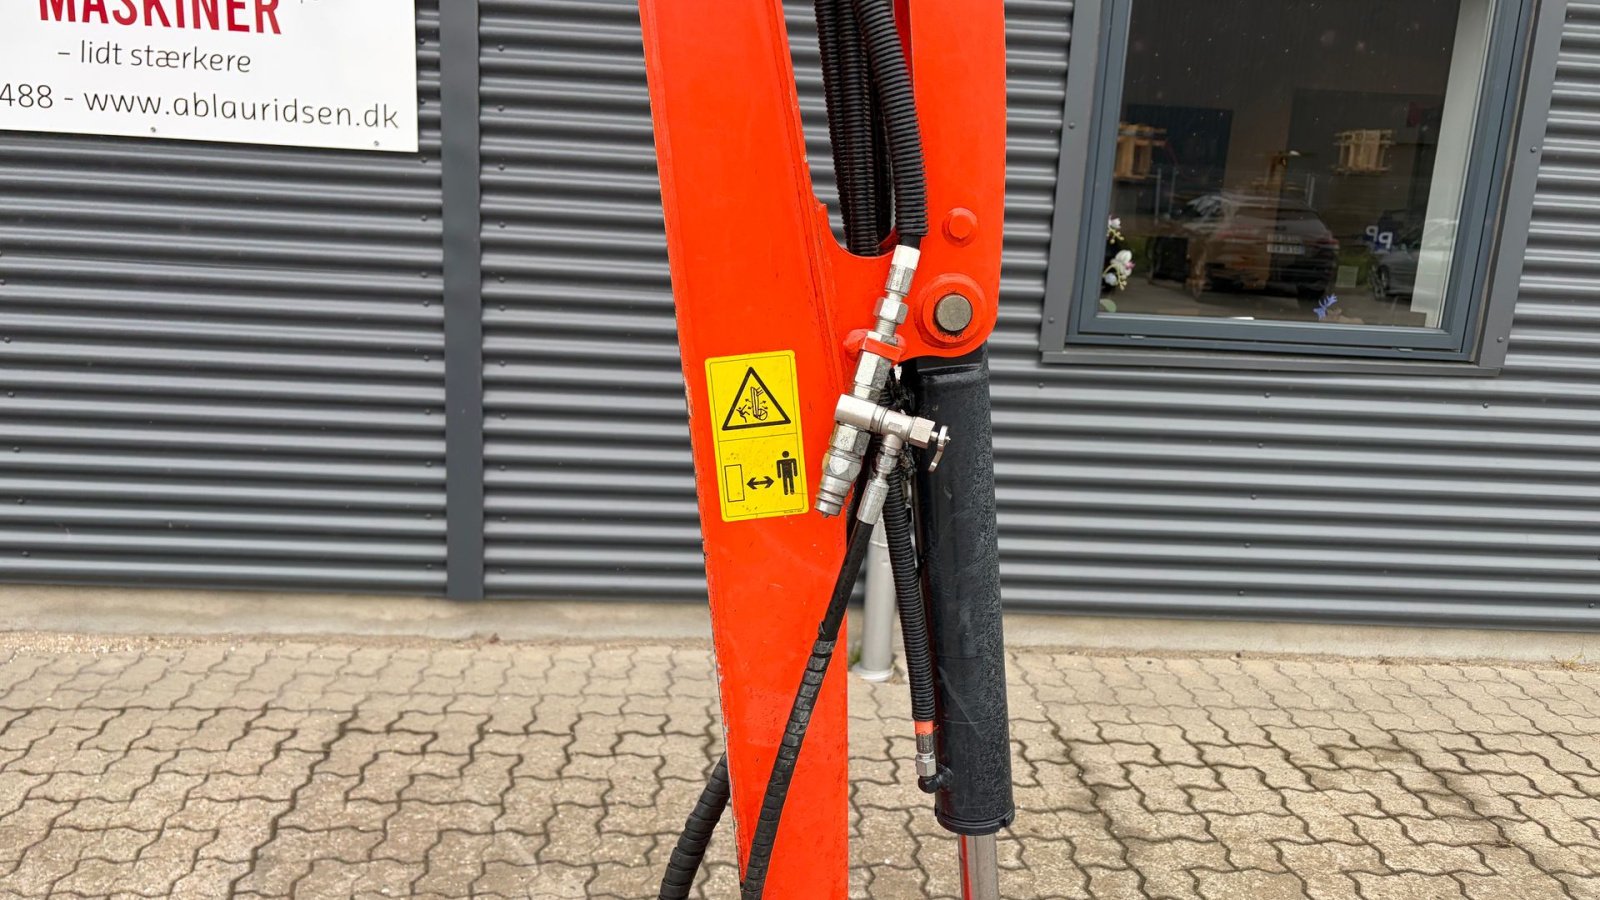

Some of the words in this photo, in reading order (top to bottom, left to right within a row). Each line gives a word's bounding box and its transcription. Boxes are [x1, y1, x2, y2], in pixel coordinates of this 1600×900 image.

[81, 39, 123, 66] lidt
[130, 44, 251, 73] stærkere
[0, 83, 54, 109] 488
[83, 92, 398, 129] www.ablauridsen.dk
